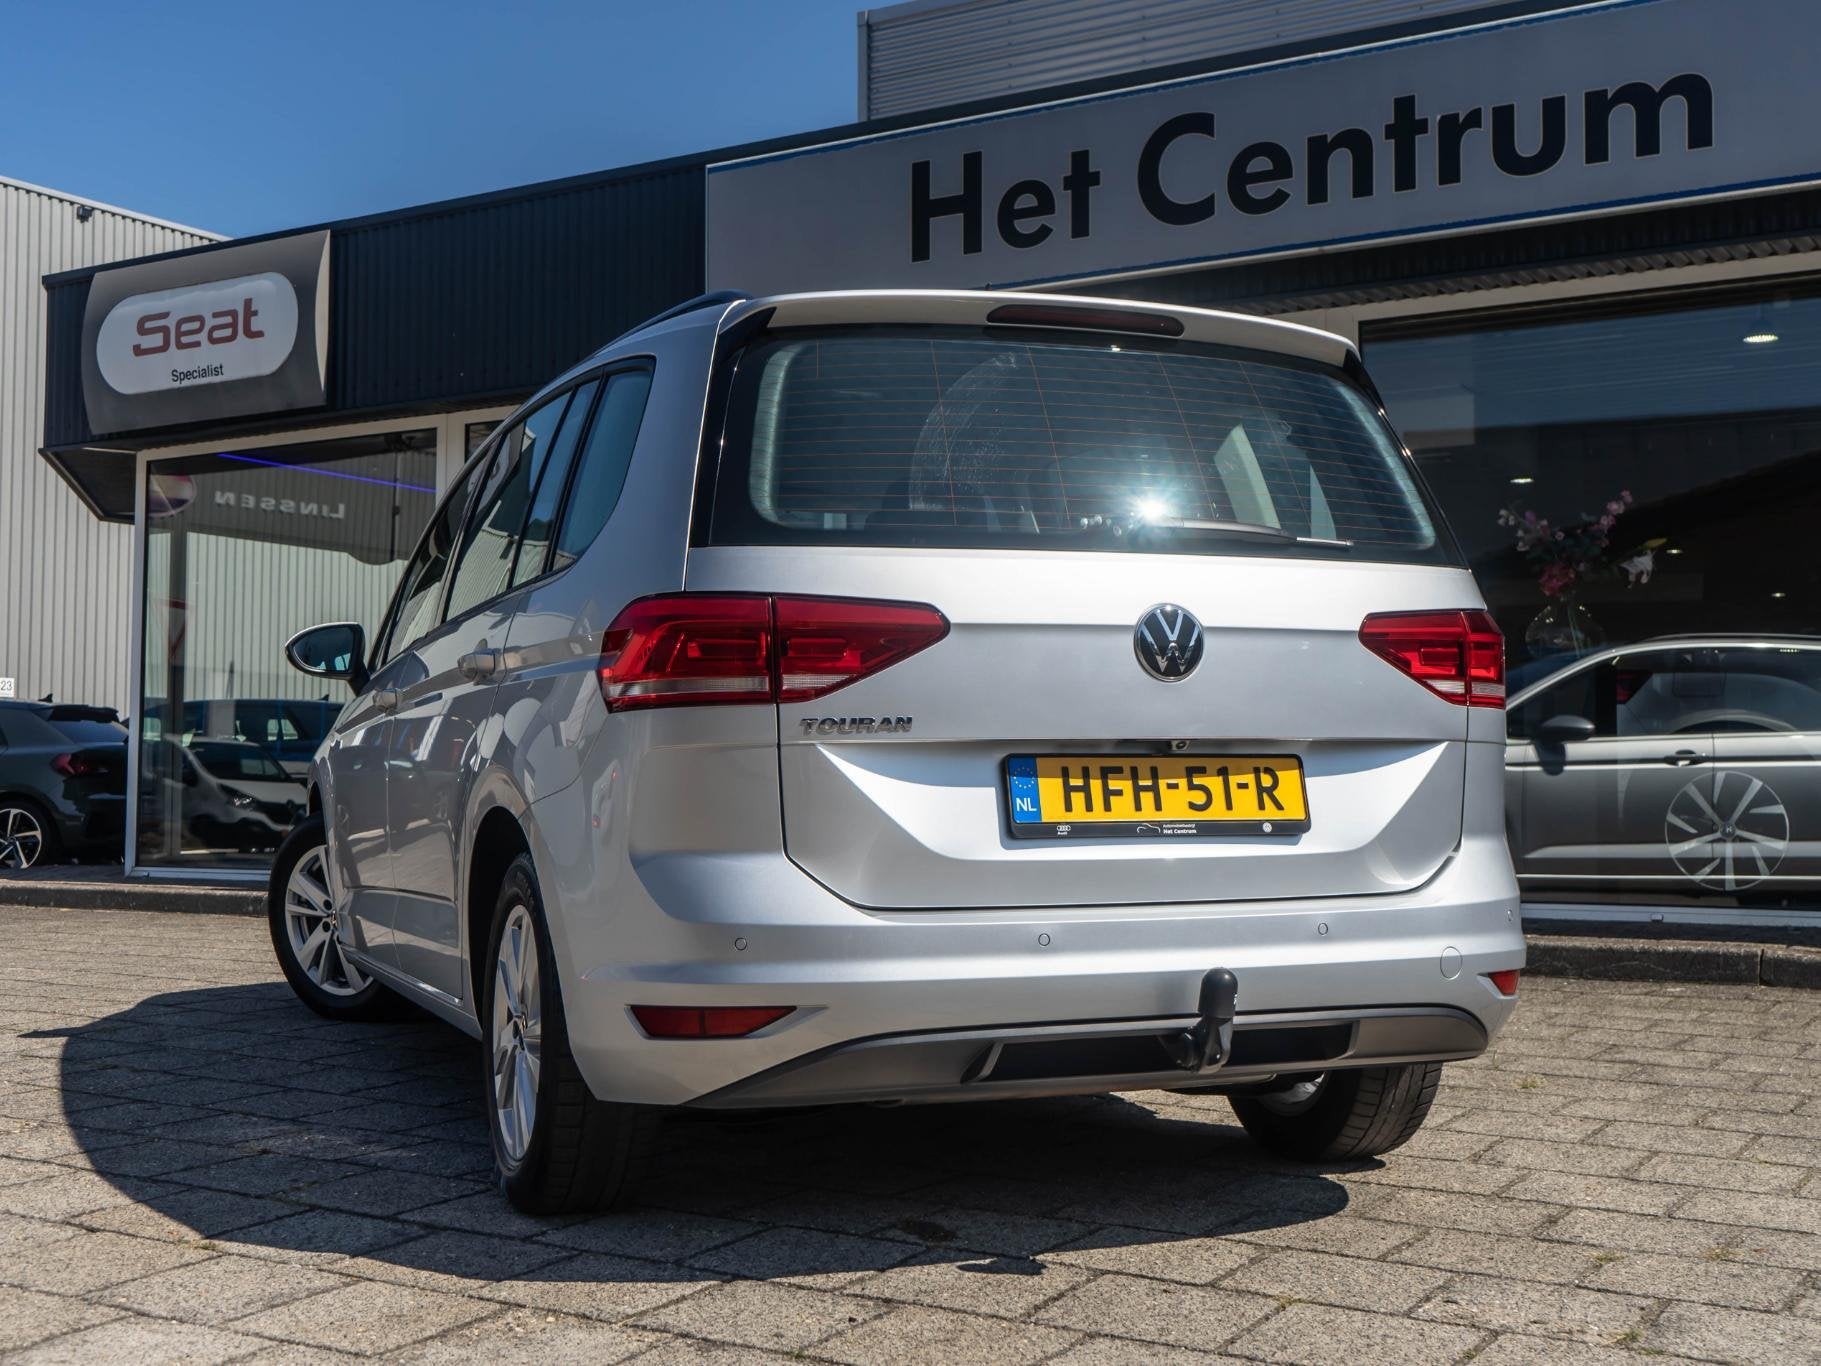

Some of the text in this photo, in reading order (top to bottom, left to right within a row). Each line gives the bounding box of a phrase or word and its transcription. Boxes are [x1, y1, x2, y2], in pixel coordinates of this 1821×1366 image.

[909, 72, 1714, 263] Het Centrum
[132, 297, 265, 357] Seat
[171, 363, 225, 384] Specialist
[800, 716, 913, 736] TOURAN
[1015, 797, 1037, 812] NL
[1061, 766, 1285, 813] HFH-51-R
